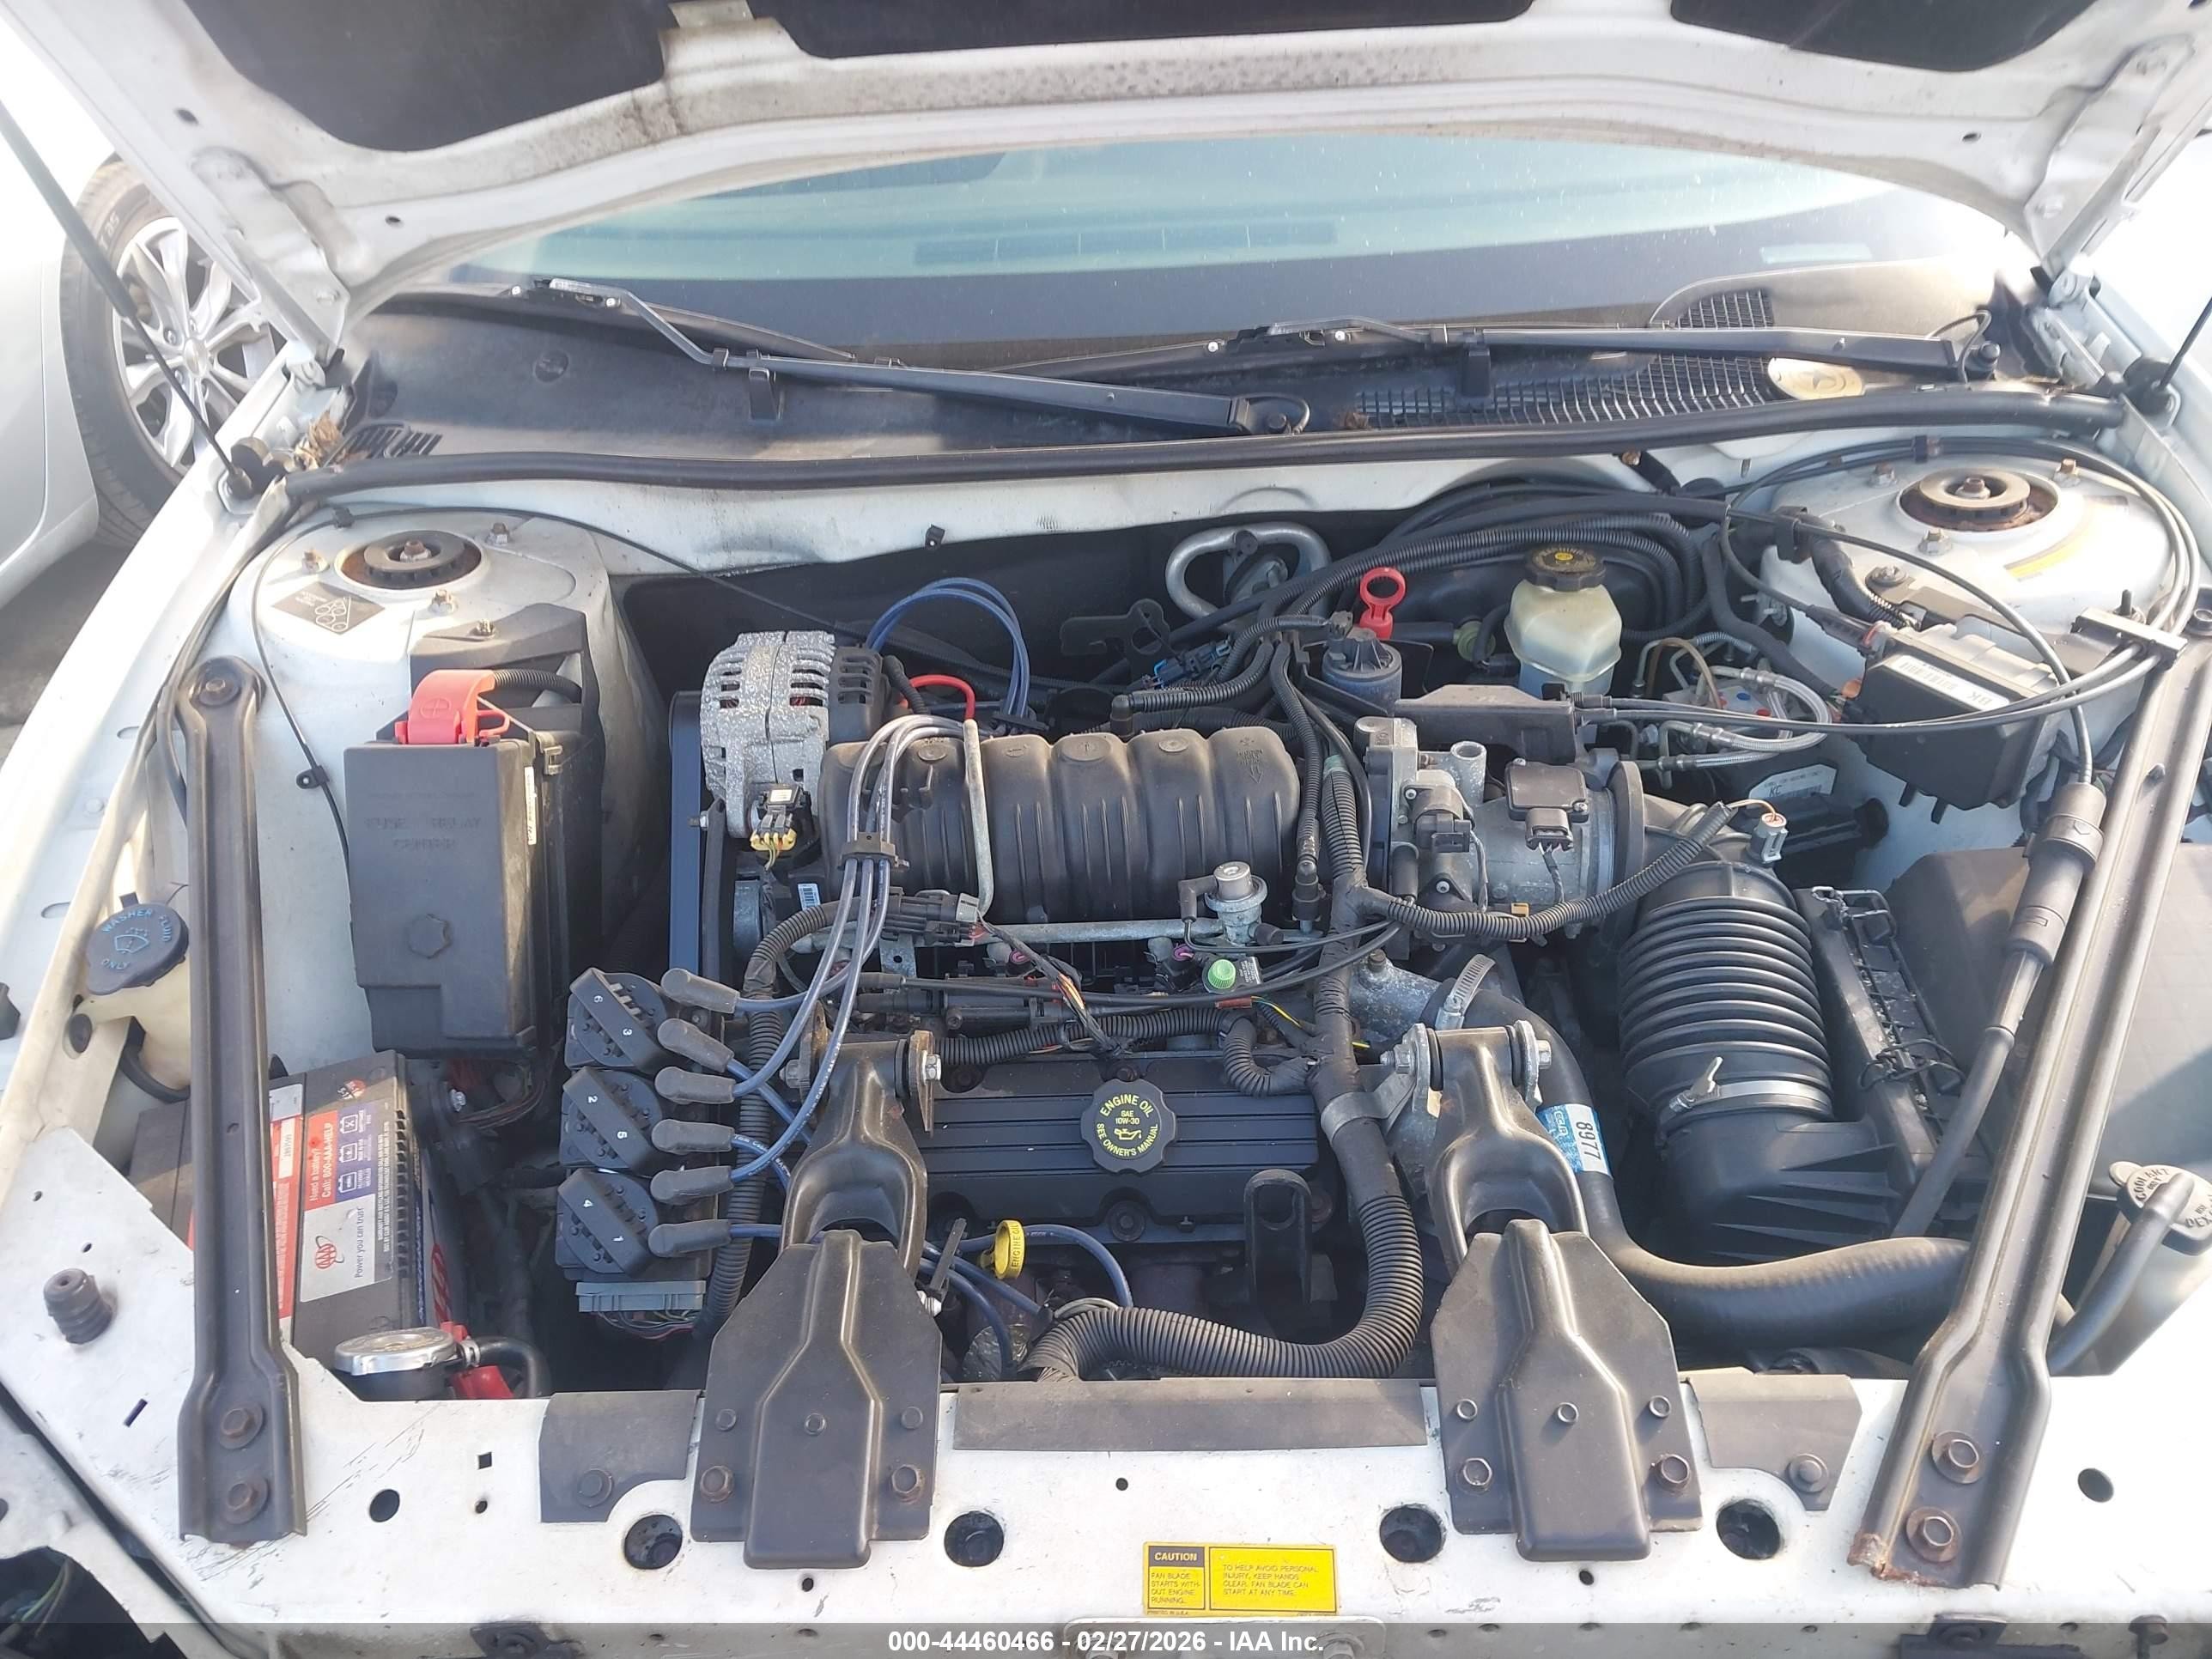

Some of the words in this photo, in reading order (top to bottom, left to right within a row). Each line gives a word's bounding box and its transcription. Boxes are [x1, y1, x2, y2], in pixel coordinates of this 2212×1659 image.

[1769, 785, 1782, 797] KC
[101, 908, 153, 934] WASHER
[158, 915, 173, 942] FLUID
[101, 957, 131, 970] ONLY
[1100, 1094, 1139, 1116] ENGINE
[1139, 1100, 1154, 1118] OIL
[322, 1122, 333, 1177] 800-AAA-HELP
[1097, 1123, 1107, 1139] SEE
[1103, 1139, 1137, 1157] OWNER'S
[1138, 1123, 1158, 1153] MANUAL
[1576, 1121, 1601, 1160] 8977
[311, 1148, 321, 1176] battery?
[309, 1182, 320, 1201] Need
[321, 1179, 331, 1197] Call:
[584, 1200, 593, 1208] 4
[1010, 1224, 1020, 1235] OIL
[356, 1239, 367, 1253] you
[1011, 1236, 1021, 1268] ENGINE
[354, 1255, 364, 1278] Power
[1154, 1553, 1197, 1561] CAUTION
